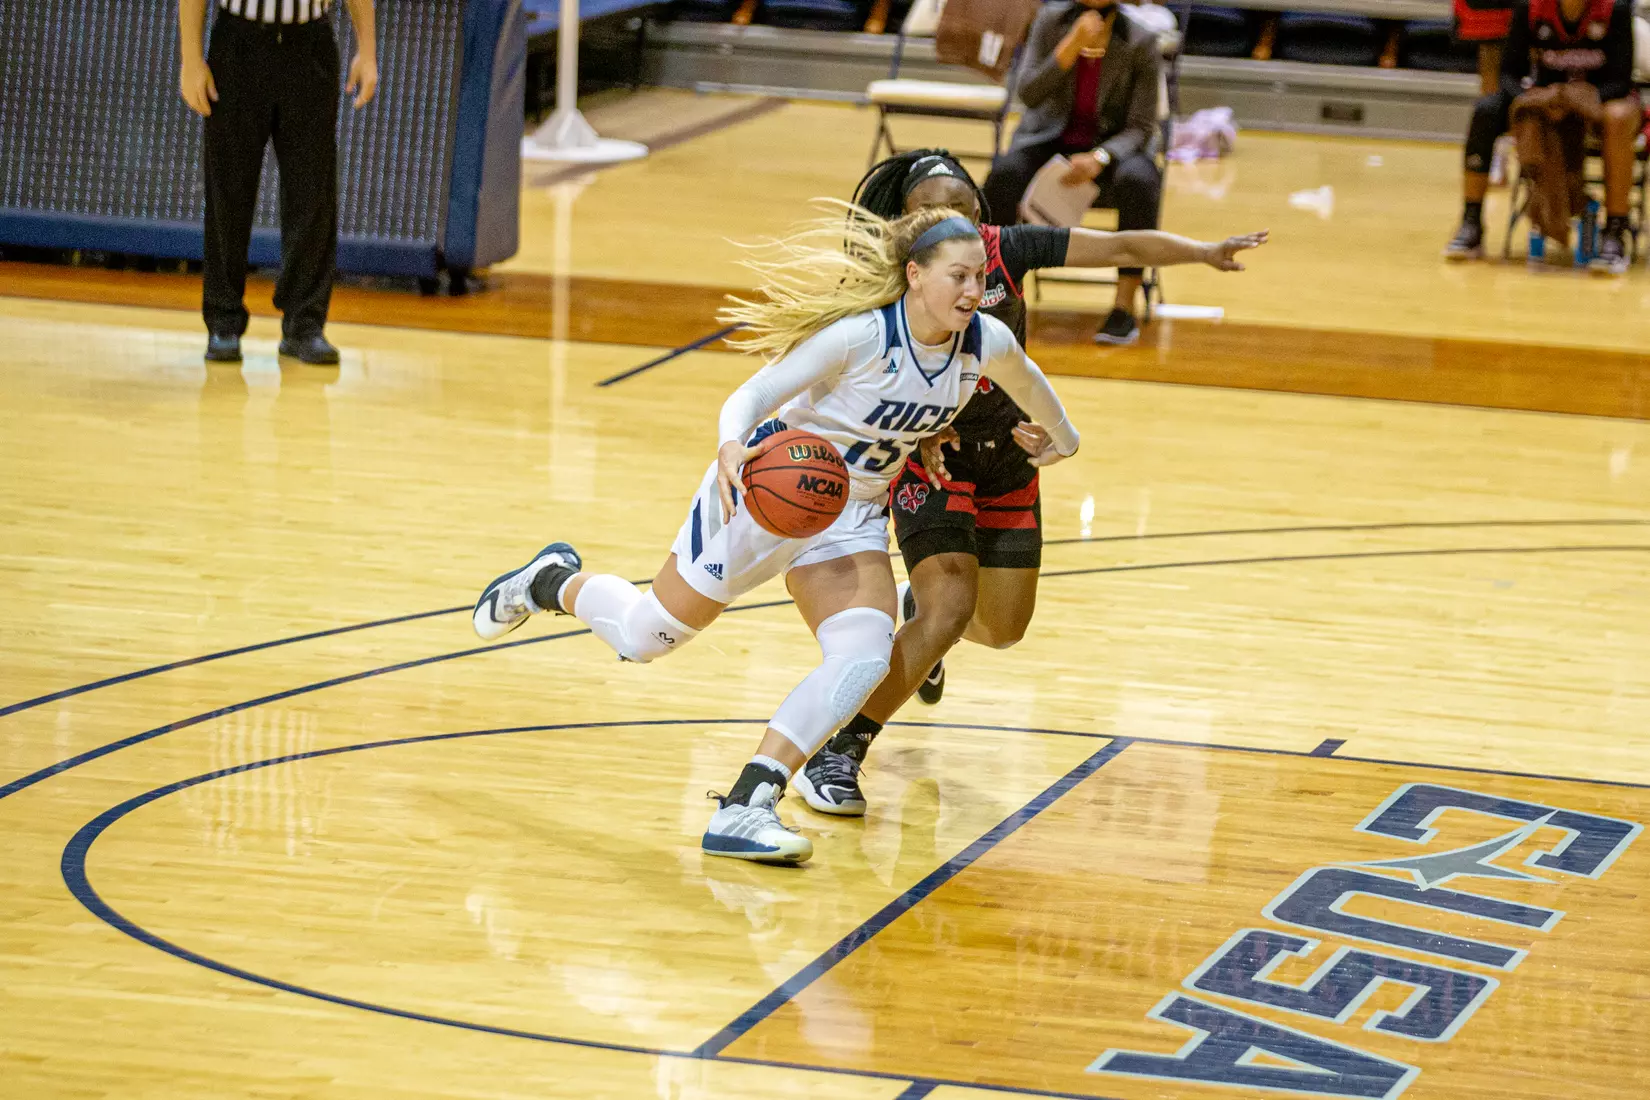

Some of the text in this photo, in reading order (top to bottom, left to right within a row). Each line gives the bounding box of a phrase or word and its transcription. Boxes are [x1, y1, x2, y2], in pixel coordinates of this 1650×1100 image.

[863, 398, 959, 433] RICE
[843, 437, 919, 472] 15
[796, 474, 844, 499] NCAA
